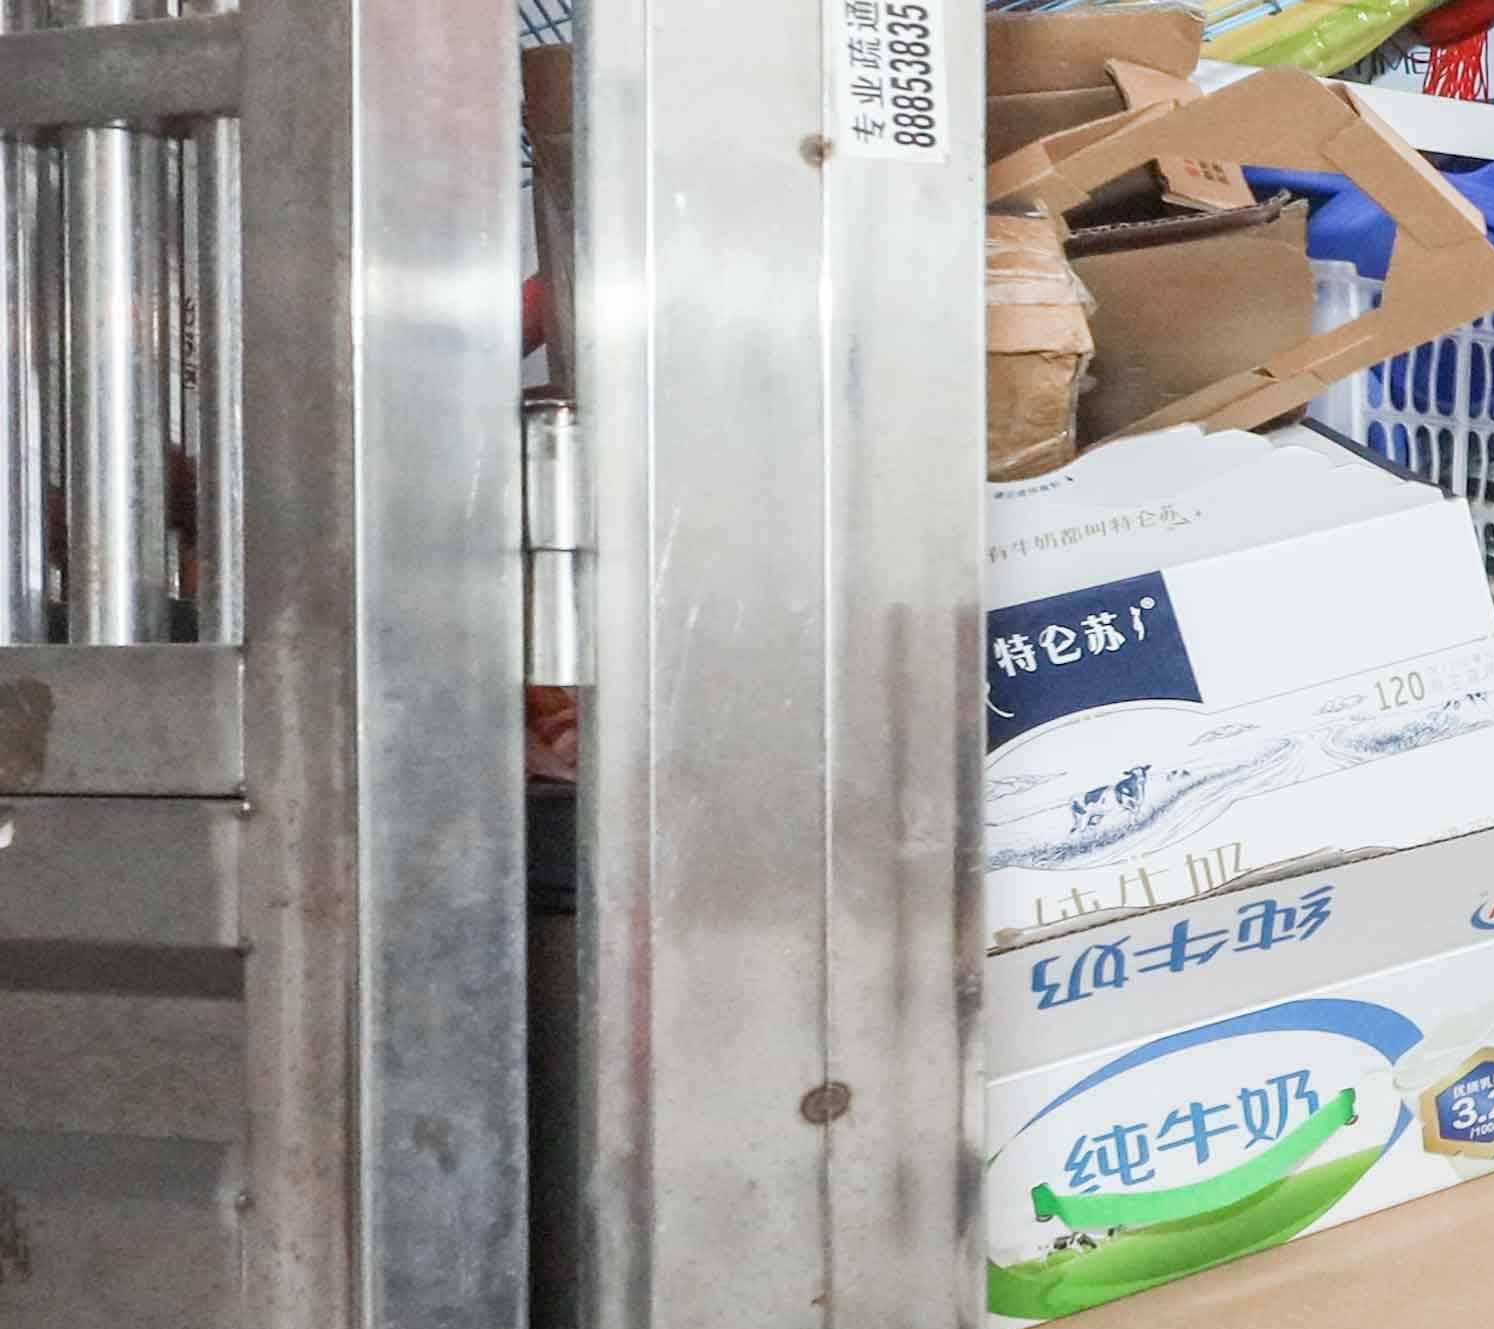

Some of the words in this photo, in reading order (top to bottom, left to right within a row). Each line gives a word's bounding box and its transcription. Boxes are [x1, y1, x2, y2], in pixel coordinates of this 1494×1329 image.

[844, 0, 886, 143] 专业疏通
[885, 3, 937, 148] 88853835
[993, 610, 1127, 677] 特仑苏
[1374, 671, 1425, 712] 120
[1030, 885, 1334, 1011] 纯牛奶
[1063, 1067, 1320, 1196] 纯牛奶
